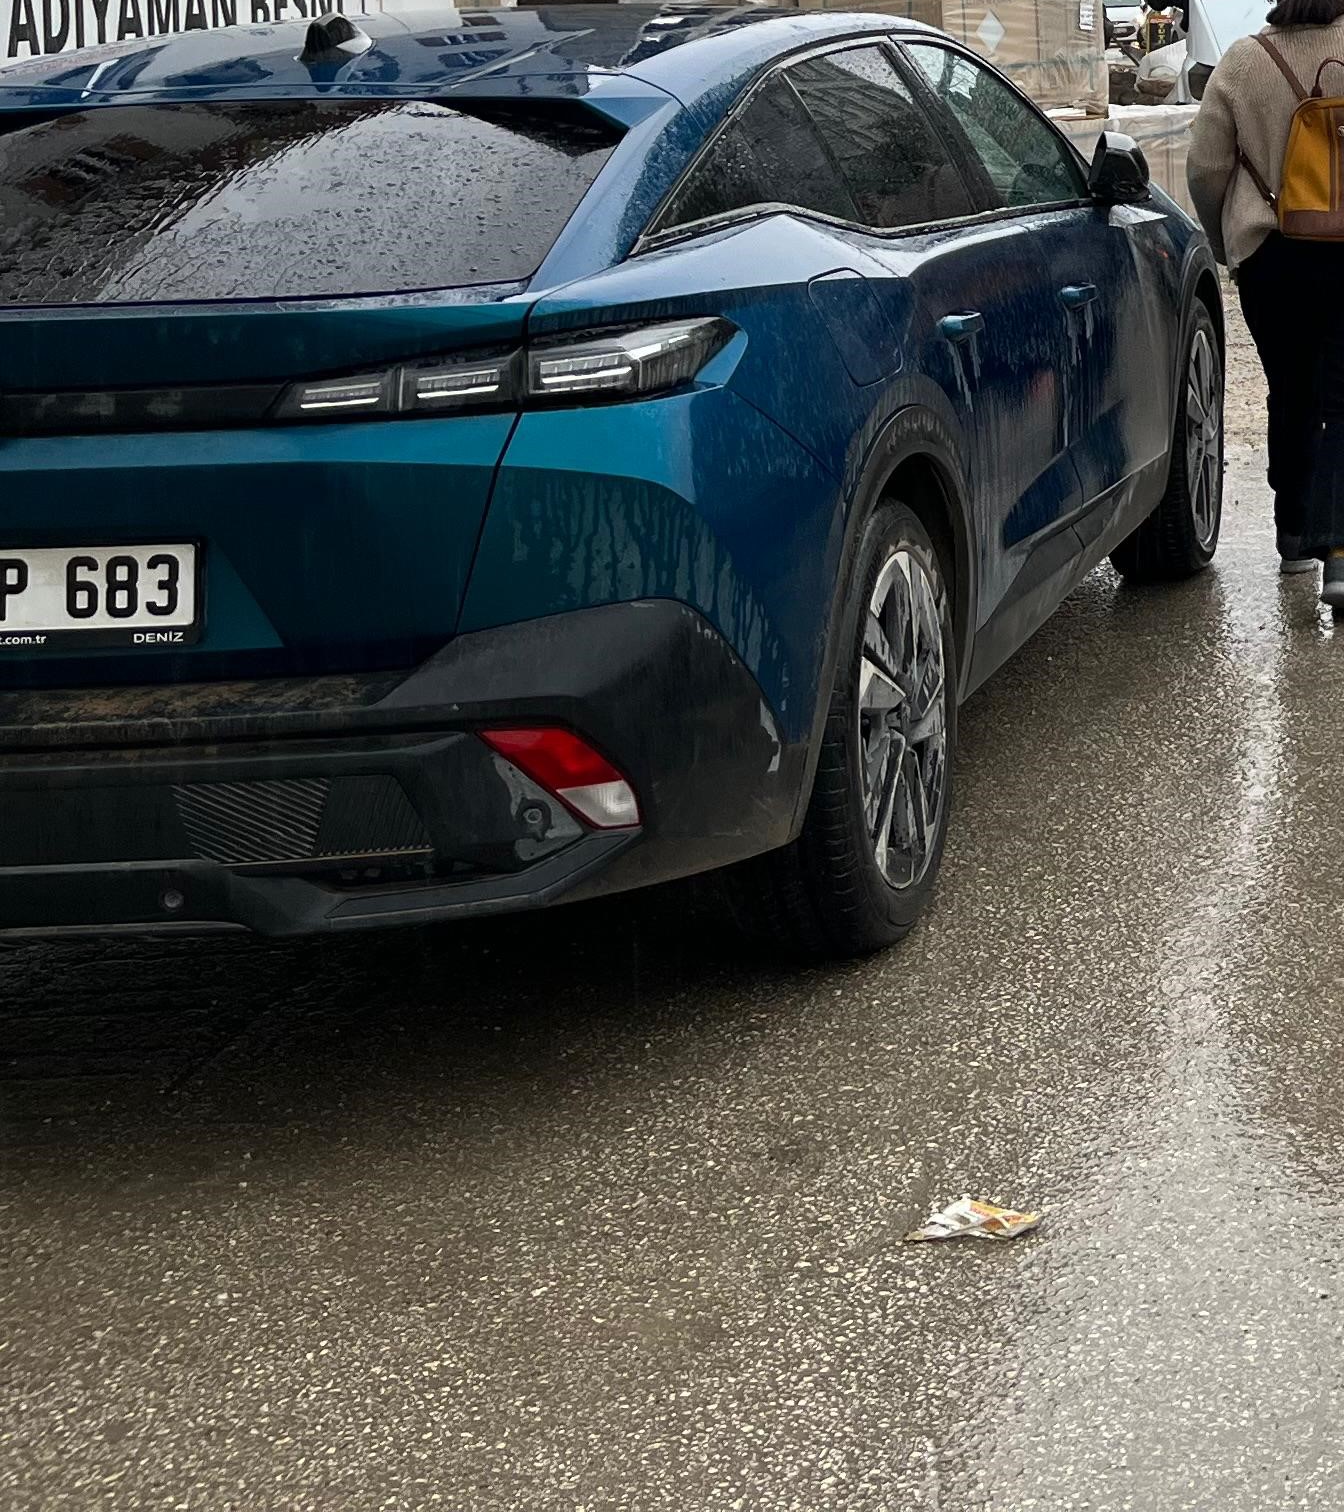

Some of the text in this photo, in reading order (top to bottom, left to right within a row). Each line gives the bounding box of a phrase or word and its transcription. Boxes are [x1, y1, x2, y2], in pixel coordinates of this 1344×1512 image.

[0, 553, 180, 622] P 683
[133, 630, 184, 644] DENİZ
